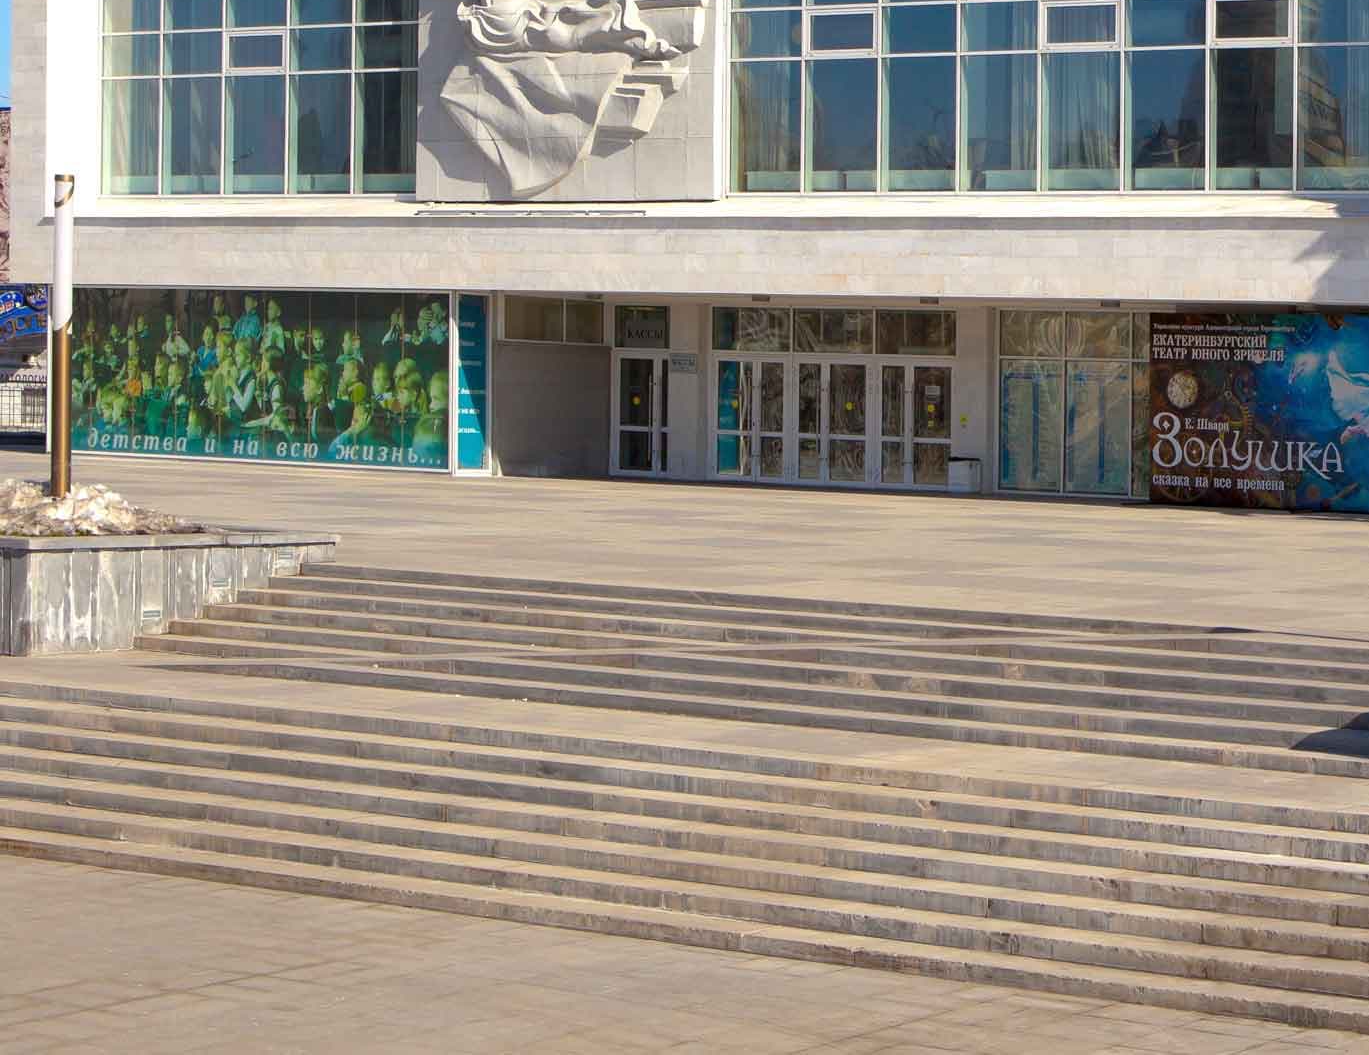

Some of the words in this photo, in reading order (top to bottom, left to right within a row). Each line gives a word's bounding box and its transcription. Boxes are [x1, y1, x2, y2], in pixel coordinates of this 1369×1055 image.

[628, 329, 663, 339] КАССЫ
[1152, 333, 1267, 348] ЕКАТЕРИНБУРГСКИЙ
[1152, 347, 1188, 360] ТЕАТР
[1192, 348, 1231, 361] ЮНОГО
[1233, 349, 1285, 362] ЗРИТЕЛЯ
[1197, 419, 1230, 433] Шварц
[88, 427, 187, 452] детства
[205, 440, 216, 453] и
[232, 440, 260, 455] на
[276, 443, 319, 460] всю
[335, 443, 442, 465] жизнь...
[1152, 474, 1189, 487] сказка
[1195, 476, 1209, 488] на
[1214, 477, 1232, 489] все
[1237, 478, 1285, 492] времена
